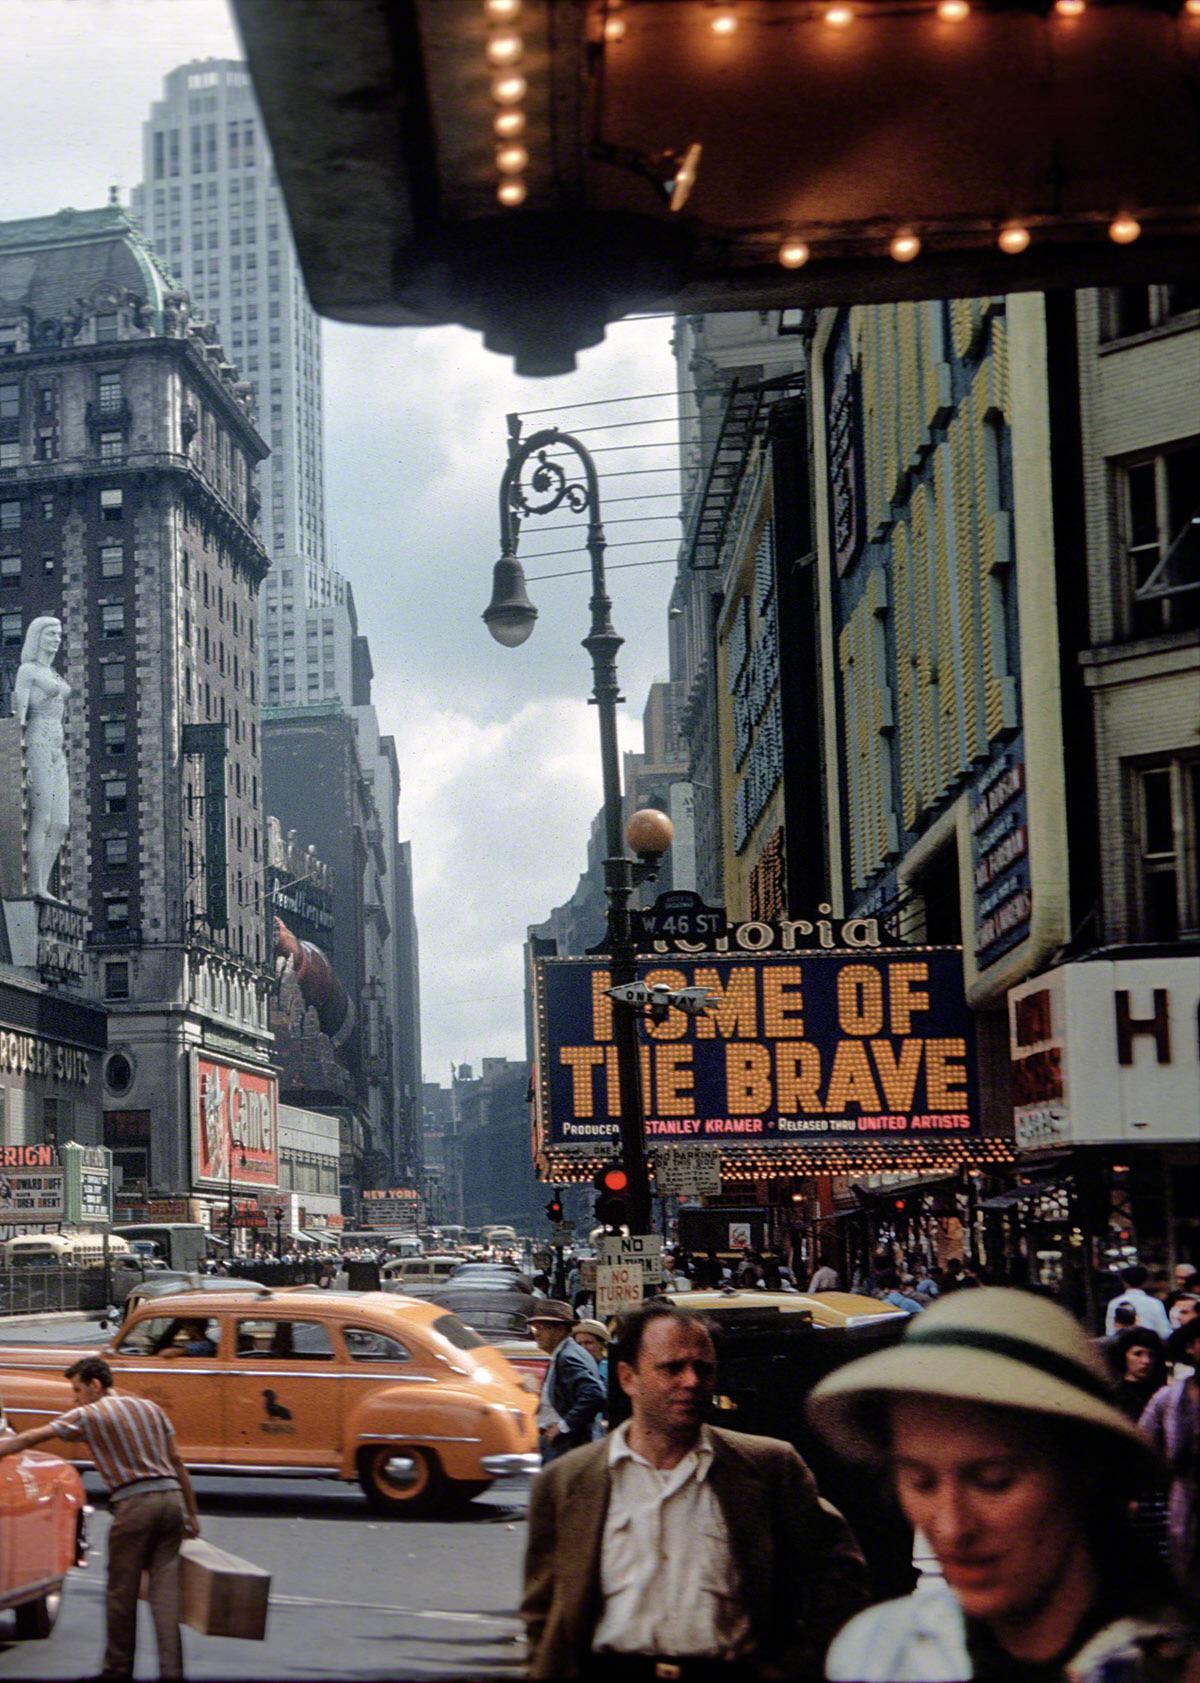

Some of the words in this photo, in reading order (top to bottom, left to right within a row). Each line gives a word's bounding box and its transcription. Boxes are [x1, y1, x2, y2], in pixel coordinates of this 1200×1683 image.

[652, 904, 882, 953] oria
[662, 915, 689, 935] 46
[696, 913, 720, 933] ST
[626, 990, 654, 1002] ONE
[667, 995, 697, 1007] WAY
[836, 961, 931, 1037] OF
[56, 1046, 90, 1084] SUITS
[725, 1037, 970, 1116] BRAVE
[643, 1119, 701, 1134] STANLEY
[704, 1118, 763, 1134] KRAMER
[777, 1116, 829, 1132] RELEASED
[830, 1118, 857, 1131] THRU
[857, 1115, 907, 1132] UNITED
[910, 1113, 971, 1131] ARTISTS
[655, 1151, 670, 1162] NO
[673, 1149, 719, 1161] PARKING
[362, 1189, 386, 1200] NEW
[621, 1239, 644, 1252] NO
[611, 1268, 629, 1284] NO
[599, 1284, 641, 1302] TURNS
